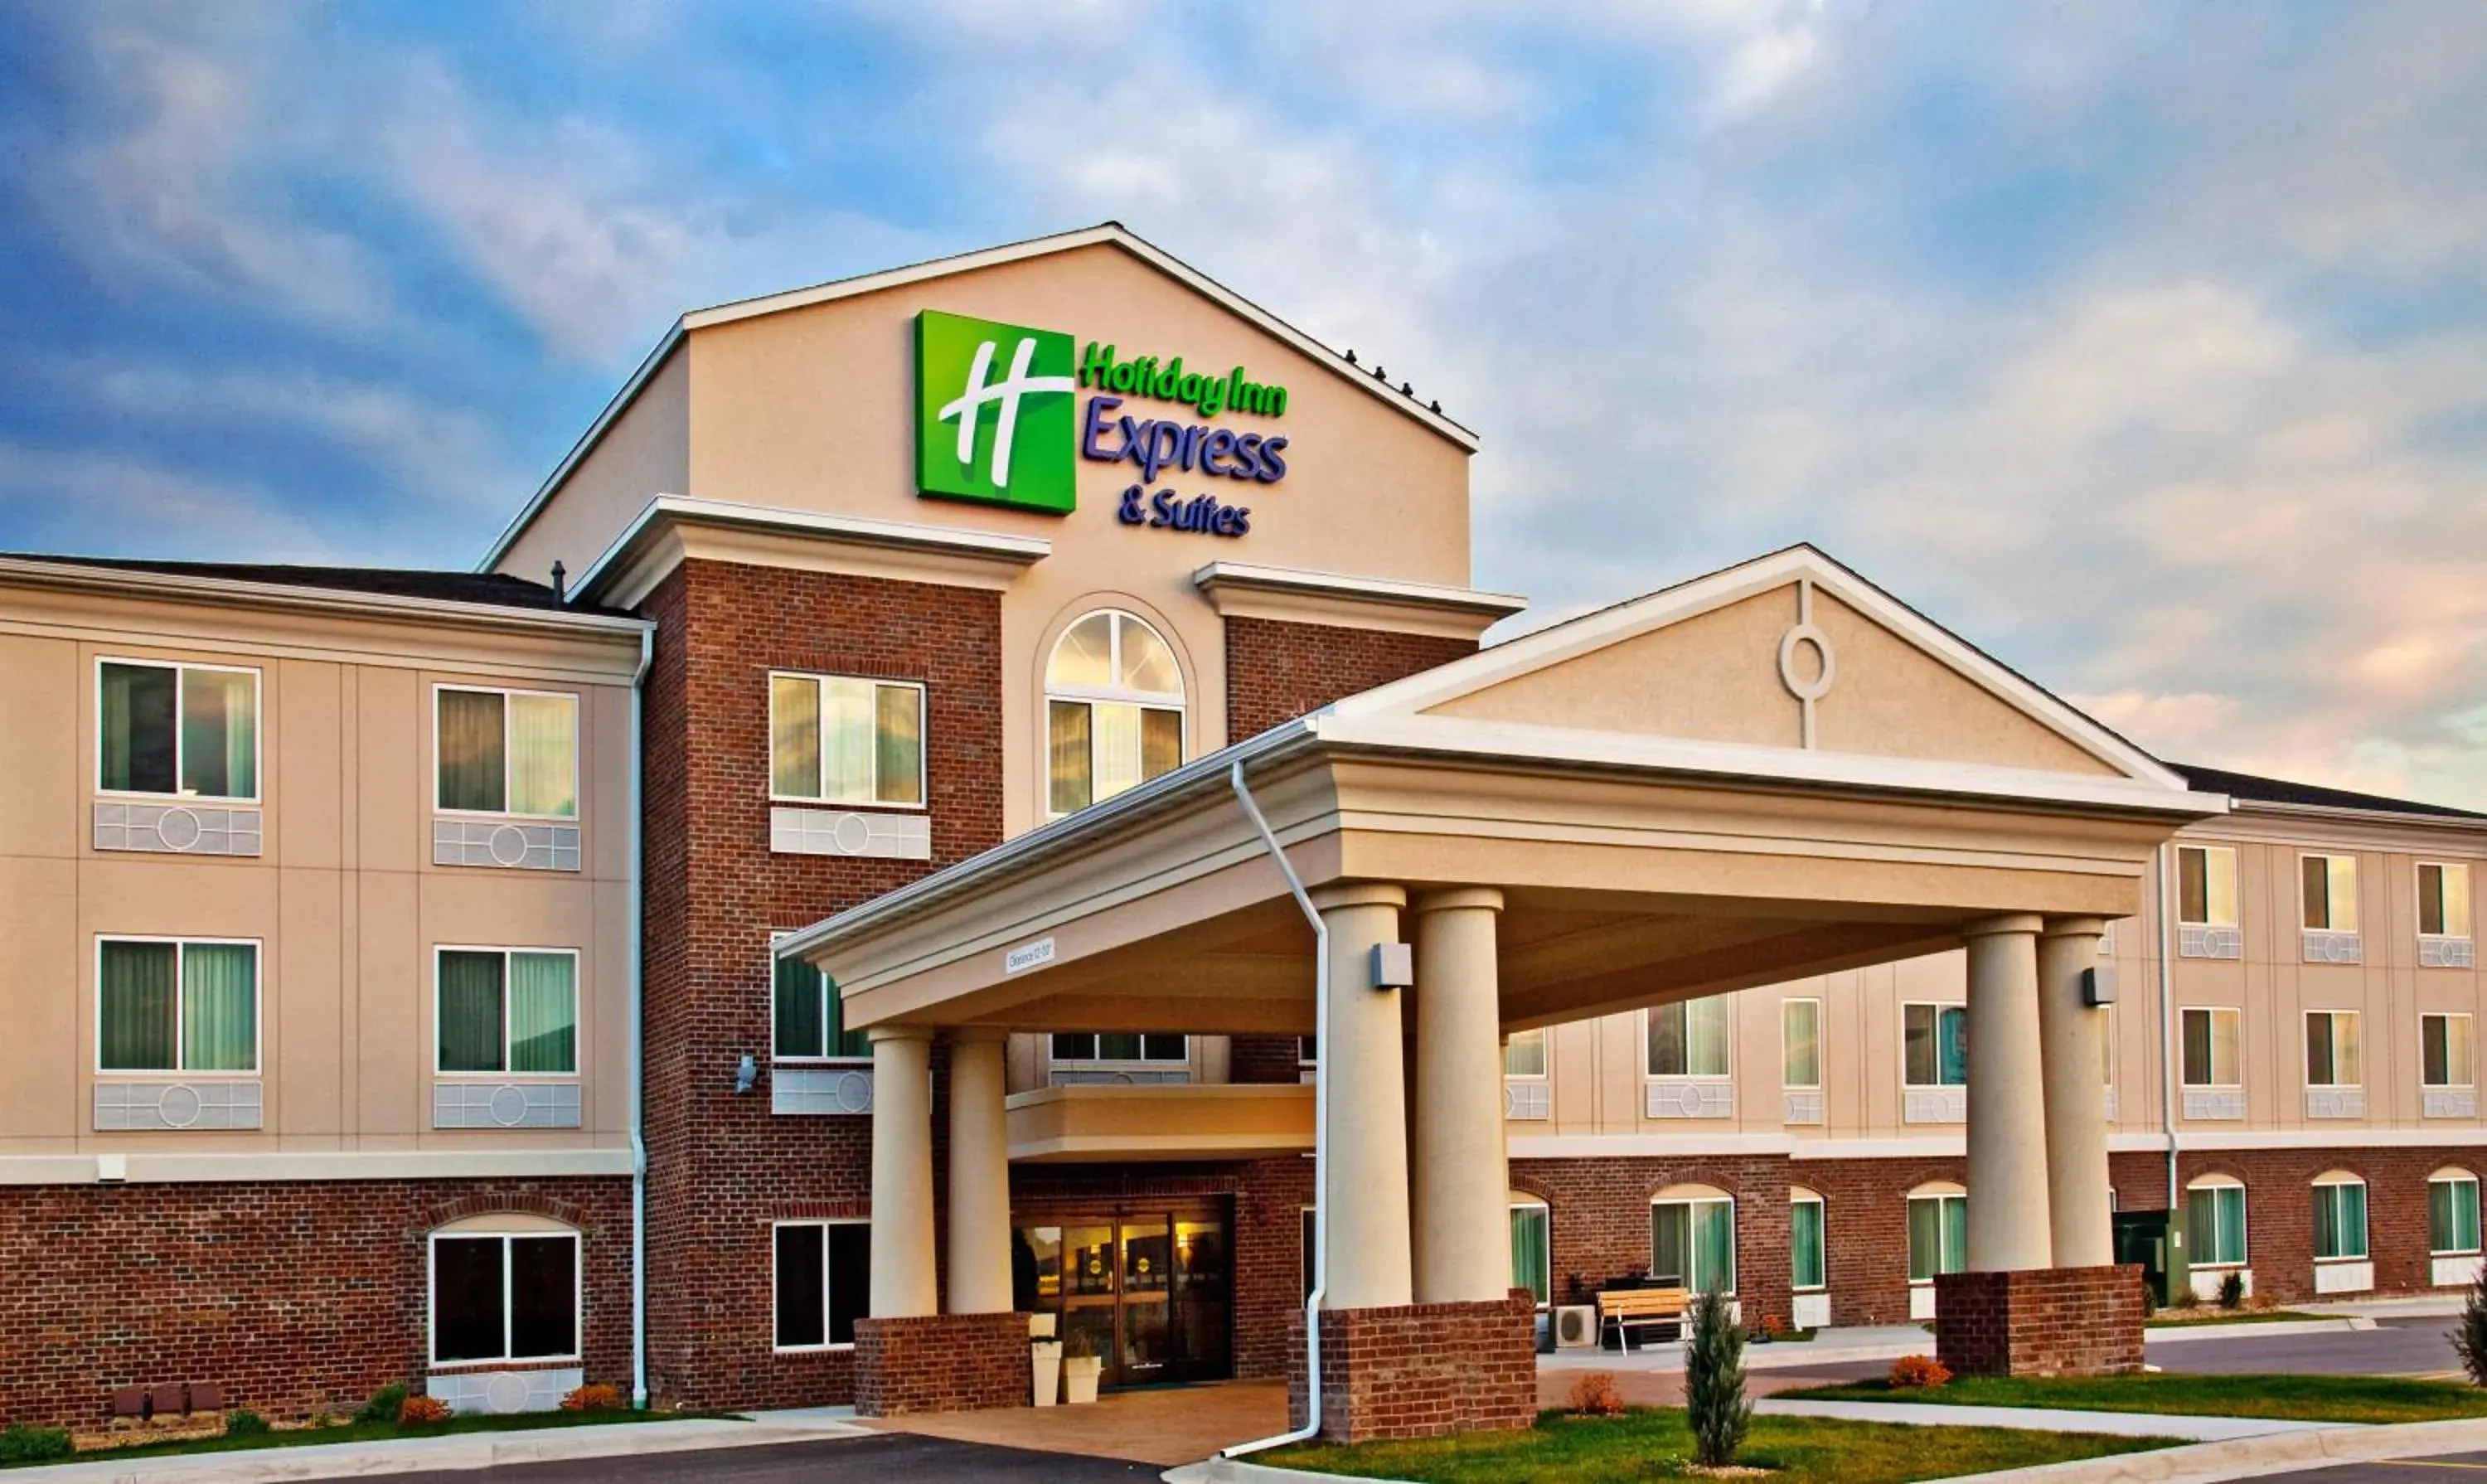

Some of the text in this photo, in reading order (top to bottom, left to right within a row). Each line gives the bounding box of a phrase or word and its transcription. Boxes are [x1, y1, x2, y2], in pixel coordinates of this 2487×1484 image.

[1079, 341, 1288, 418] Holiday Inn
[1083, 395, 1289, 484] Express
[1118, 483, 1251, 537] & Suites
